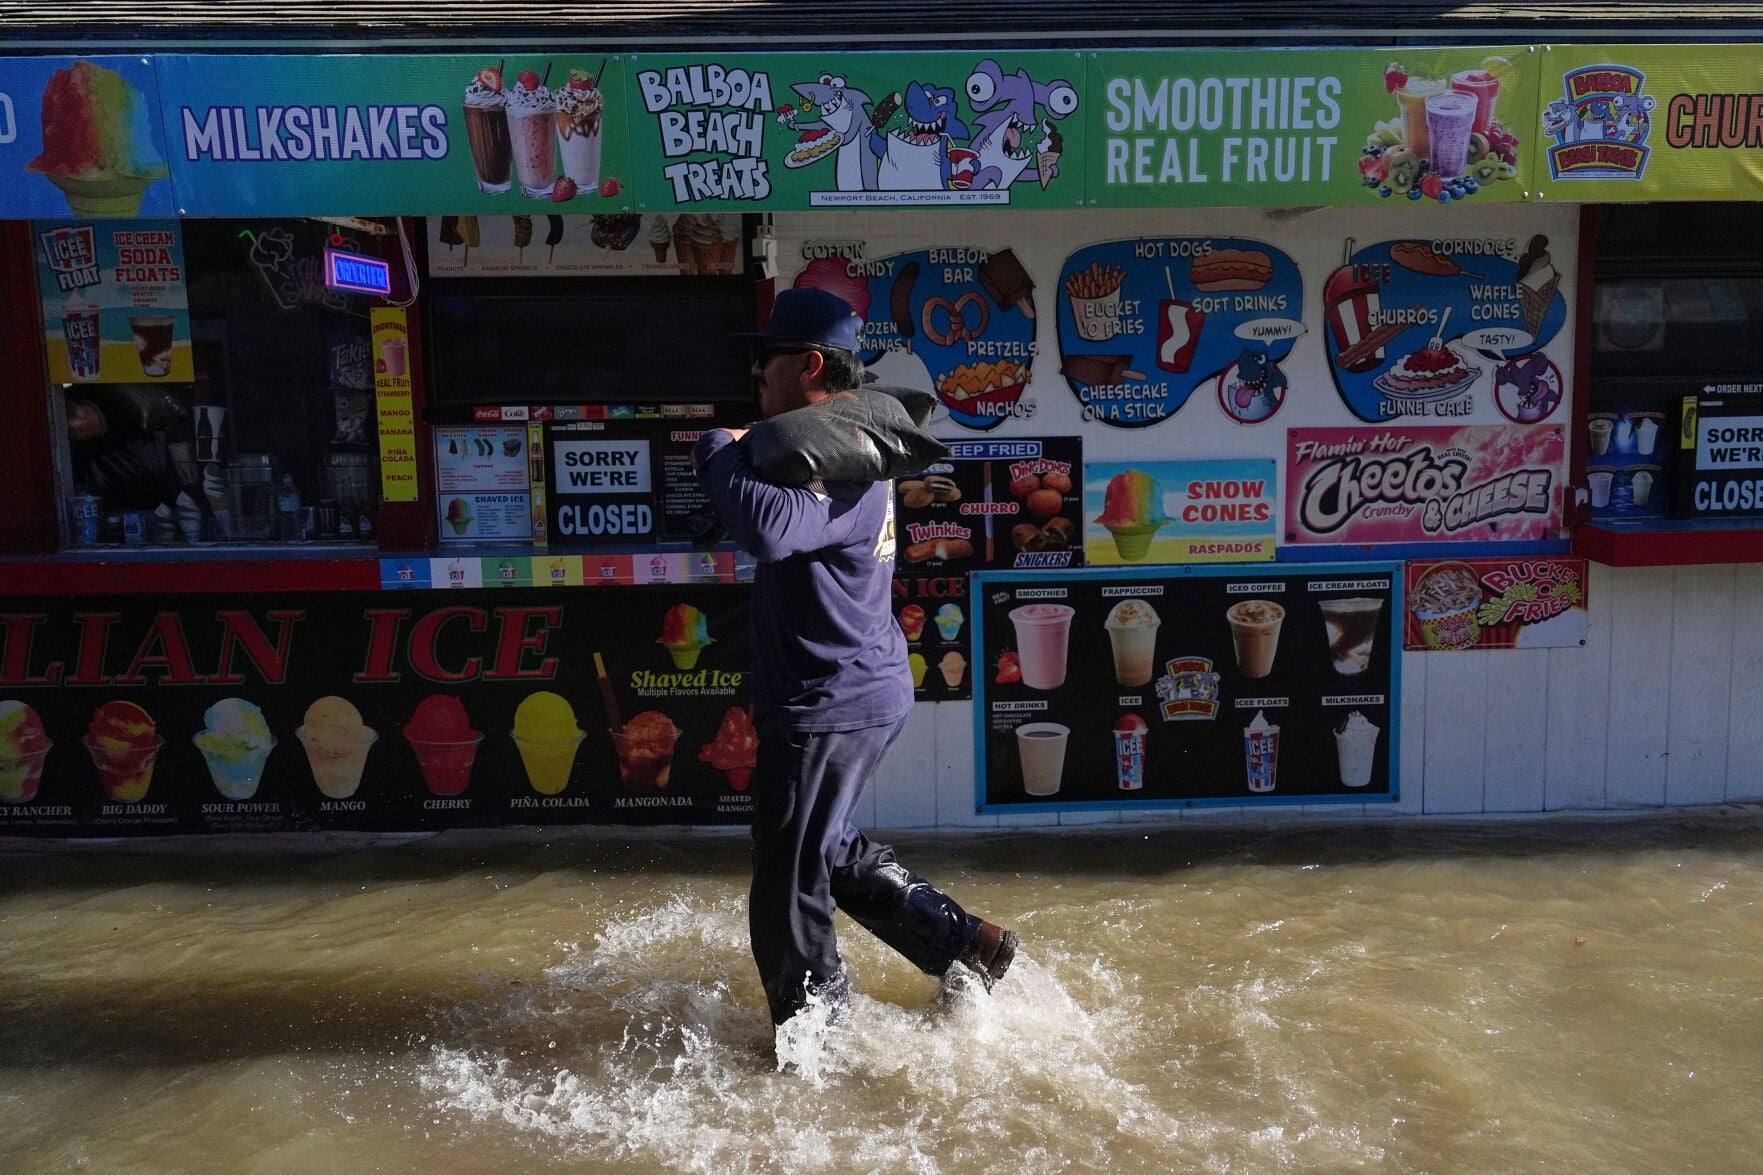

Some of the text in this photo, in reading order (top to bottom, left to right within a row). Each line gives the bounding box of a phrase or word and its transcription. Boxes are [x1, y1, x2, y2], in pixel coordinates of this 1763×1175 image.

[636, 64, 772, 113] BALBOA
[1574, 73, 1631, 95] BALBOA
[1106, 76, 1342, 133] SMOOTHIES
[1666, 94, 1763, 150] CHUR
[183, 105, 449, 161] MILKSHAKES
[659, 107, 762, 158] BEACH
[1106, 135, 1339, 186] REAL FRUIT
[1558, 146, 1638, 169] BEACH TREATS
[664, 157, 771, 204] TREATS
[821, 193, 1001, 204] NEWPORT BEACH, CALIFORNIA EST. 1969
[114, 232, 173, 246] ICE CREAM
[53, 236, 87, 261] ICEE
[120, 248, 171, 266] SODA
[802, 243, 864, 260] COTTON
[929, 249, 988, 264] BALBOA
[1134, 241, 1212, 258] HOT DOGS
[1431, 240, 1517, 257] CORNDOGS
[114, 267, 180, 283] FLOATS
[336, 259, 365, 284] ORDER
[846, 262, 895, 278] CANDY
[943, 268, 973, 284] BAR
[58, 269, 100, 290] FLOAT
[1470, 284, 1523, 301] WAFFLE
[1085, 300, 1140, 318] BUCKET
[1192, 295, 1287, 314] SOFT DRINKS
[1471, 304, 1520, 320] CONES
[1368, 308, 1438, 325] CHURROS
[66, 319, 95, 339] ICEE
[373, 322, 407, 333] SMOOTHIES
[864, 322, 898, 335] OZEN
[1103, 319, 1145, 336] FRIES
[1252, 325, 1292, 337] YUMMY!
[862, 339, 903, 352] NANAS
[1480, 334, 1516, 345] TASTY!
[332, 342, 371, 368] Takis
[967, 341, 1038, 357] PRETZELS
[377, 378, 392, 388] REAL
[393, 377, 410, 388] FRUIT
[1717, 384, 1763, 394] ORDER NEXT
[1080, 383, 1168, 401] CHEESECAKE
[505, 410, 524, 418] Coke
[976, 401, 1036, 418] NACHOS
[1083, 402, 1167, 420] ON A STICK
[1378, 399, 1473, 417] FUNNEL CAKE
[952, 444, 1038, 457] EEP FRIED
[1296, 433, 1412, 463] Flamin' Hot
[1710, 447, 1763, 463] WE'R
[564, 450, 639, 467] SORRY
[569, 470, 638, 486] WE'RE
[1010, 458, 1071, 483] DING DONGS
[1187, 480, 1264, 500] SNOW
[1300, 447, 1467, 533] Cheetos
[960, 502, 1019, 515] CHURRO
[1423, 470, 1551, 532] & CHEESE
[557, 504, 652, 535] CLOSED
[1182, 503, 1269, 523] CONES
[1360, 504, 1415, 519] Crunchy
[907, 520, 971, 544] Twinkies
[1189, 543, 1263, 555] RASPADOS
[1014, 551, 1072, 567] SNICKERS
[1481, 561, 1579, 593] BUCKET
[916, 577, 965, 598] ICE
[1017, 590, 1066, 598] SMOOTHIES
[1504, 593, 1573, 623] FRIES
[353, 604, 564, 686] ICE
[631, 669, 743, 688] Shaved Ice
[638, 686, 736, 698] Multiple Flavors Available
[1326, 696, 1380, 704] MILKSHAKES
[1257, 698, 1288, 706] FLOATS
[1119, 738, 1143, 756] ICEE
[1249, 736, 1274, 756] ICEE
[202, 802, 281, 813] SOUR POWER
[320, 801, 368, 811] MANGO
[424, 799, 472, 810] CHERRY
[510, 796, 590, 809] PIÑA COLADA
[615, 796, 693, 808] MANGONADA
[719, 795, 751, 803] SHAVED
[13, 805, 72, 816] RANCHER
[102, 803, 168, 815] BIG DADDY
